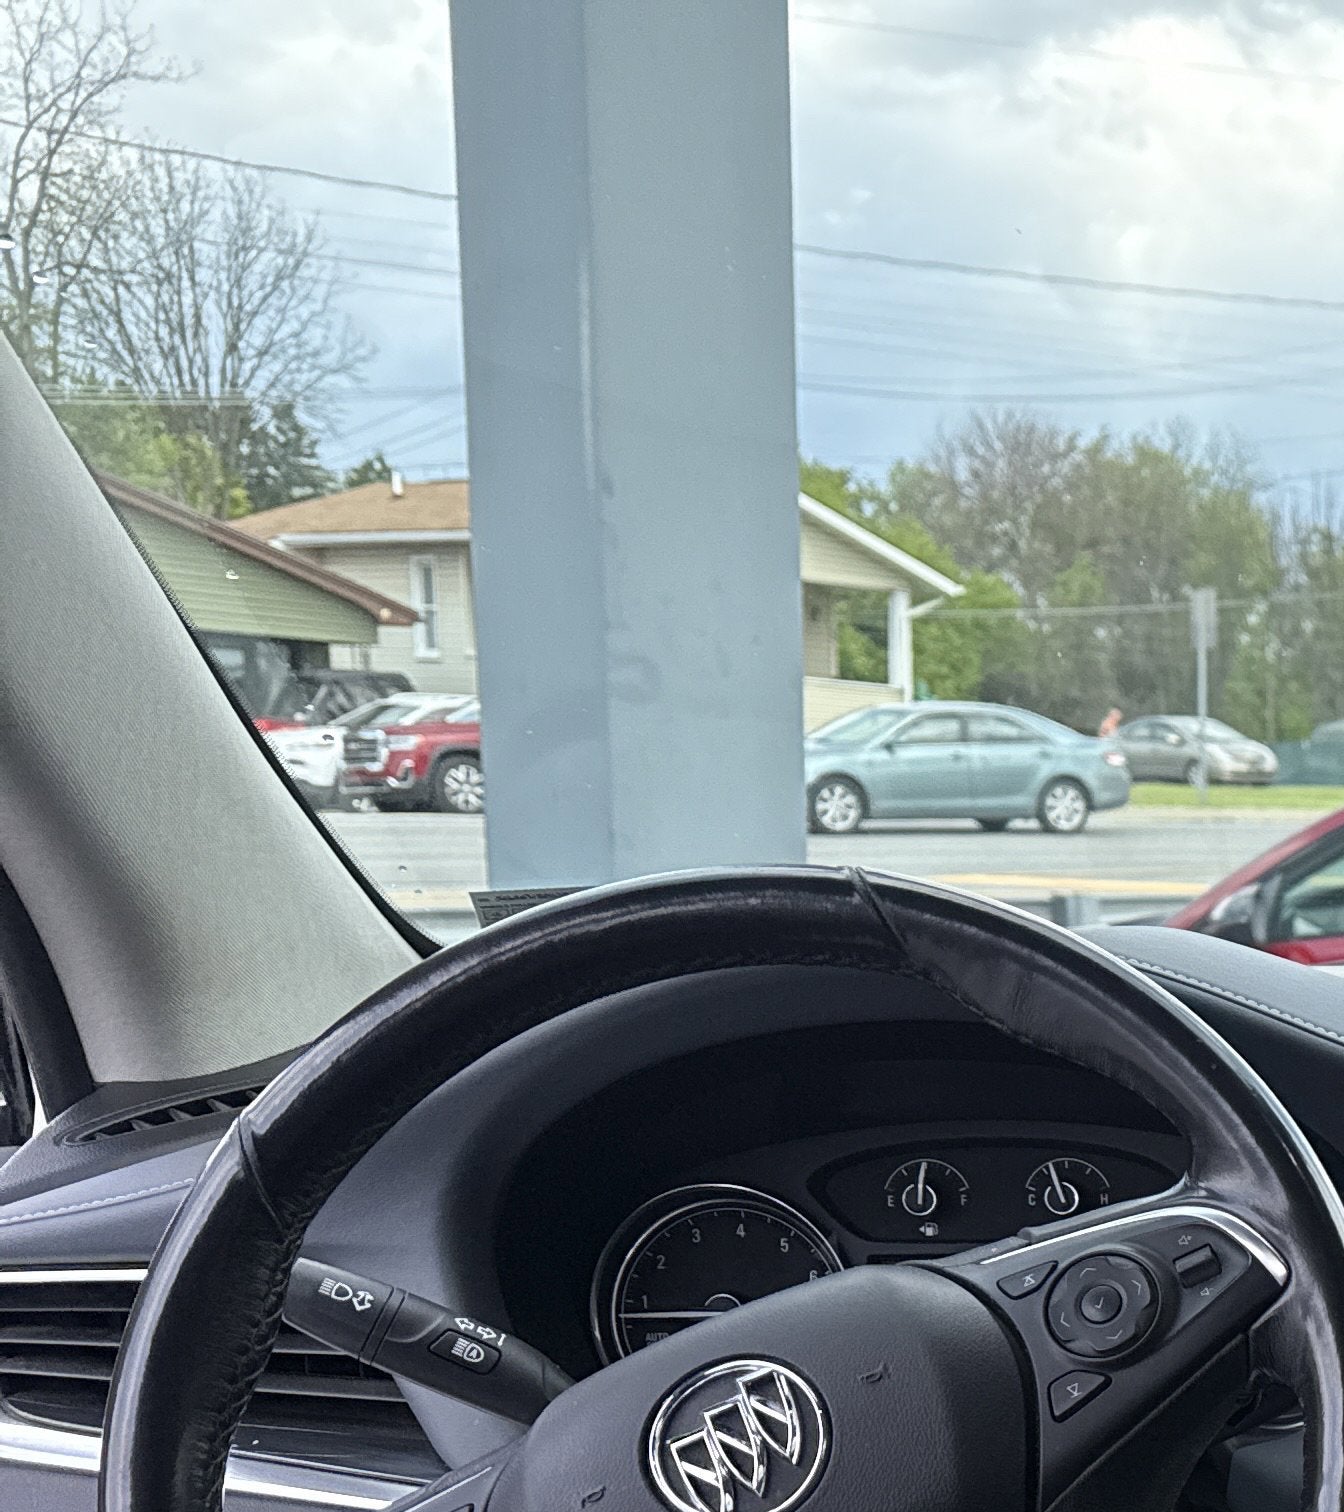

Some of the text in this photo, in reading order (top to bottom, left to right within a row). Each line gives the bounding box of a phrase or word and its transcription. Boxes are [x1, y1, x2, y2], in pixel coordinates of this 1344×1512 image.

[887, 1194, 895, 1207] E
[960, 1194, 968, 1206] F
[1028, 1194, 1037, 1206] C
[1100, 1194, 1109, 1206] H
[691, 1228, 701, 1243] 3
[736, 1223, 746, 1238] 4
[780, 1237, 790, 1253] 5
[656, 1254, 667, 1270] 2
[642, 1295, 649, 1310] 1
